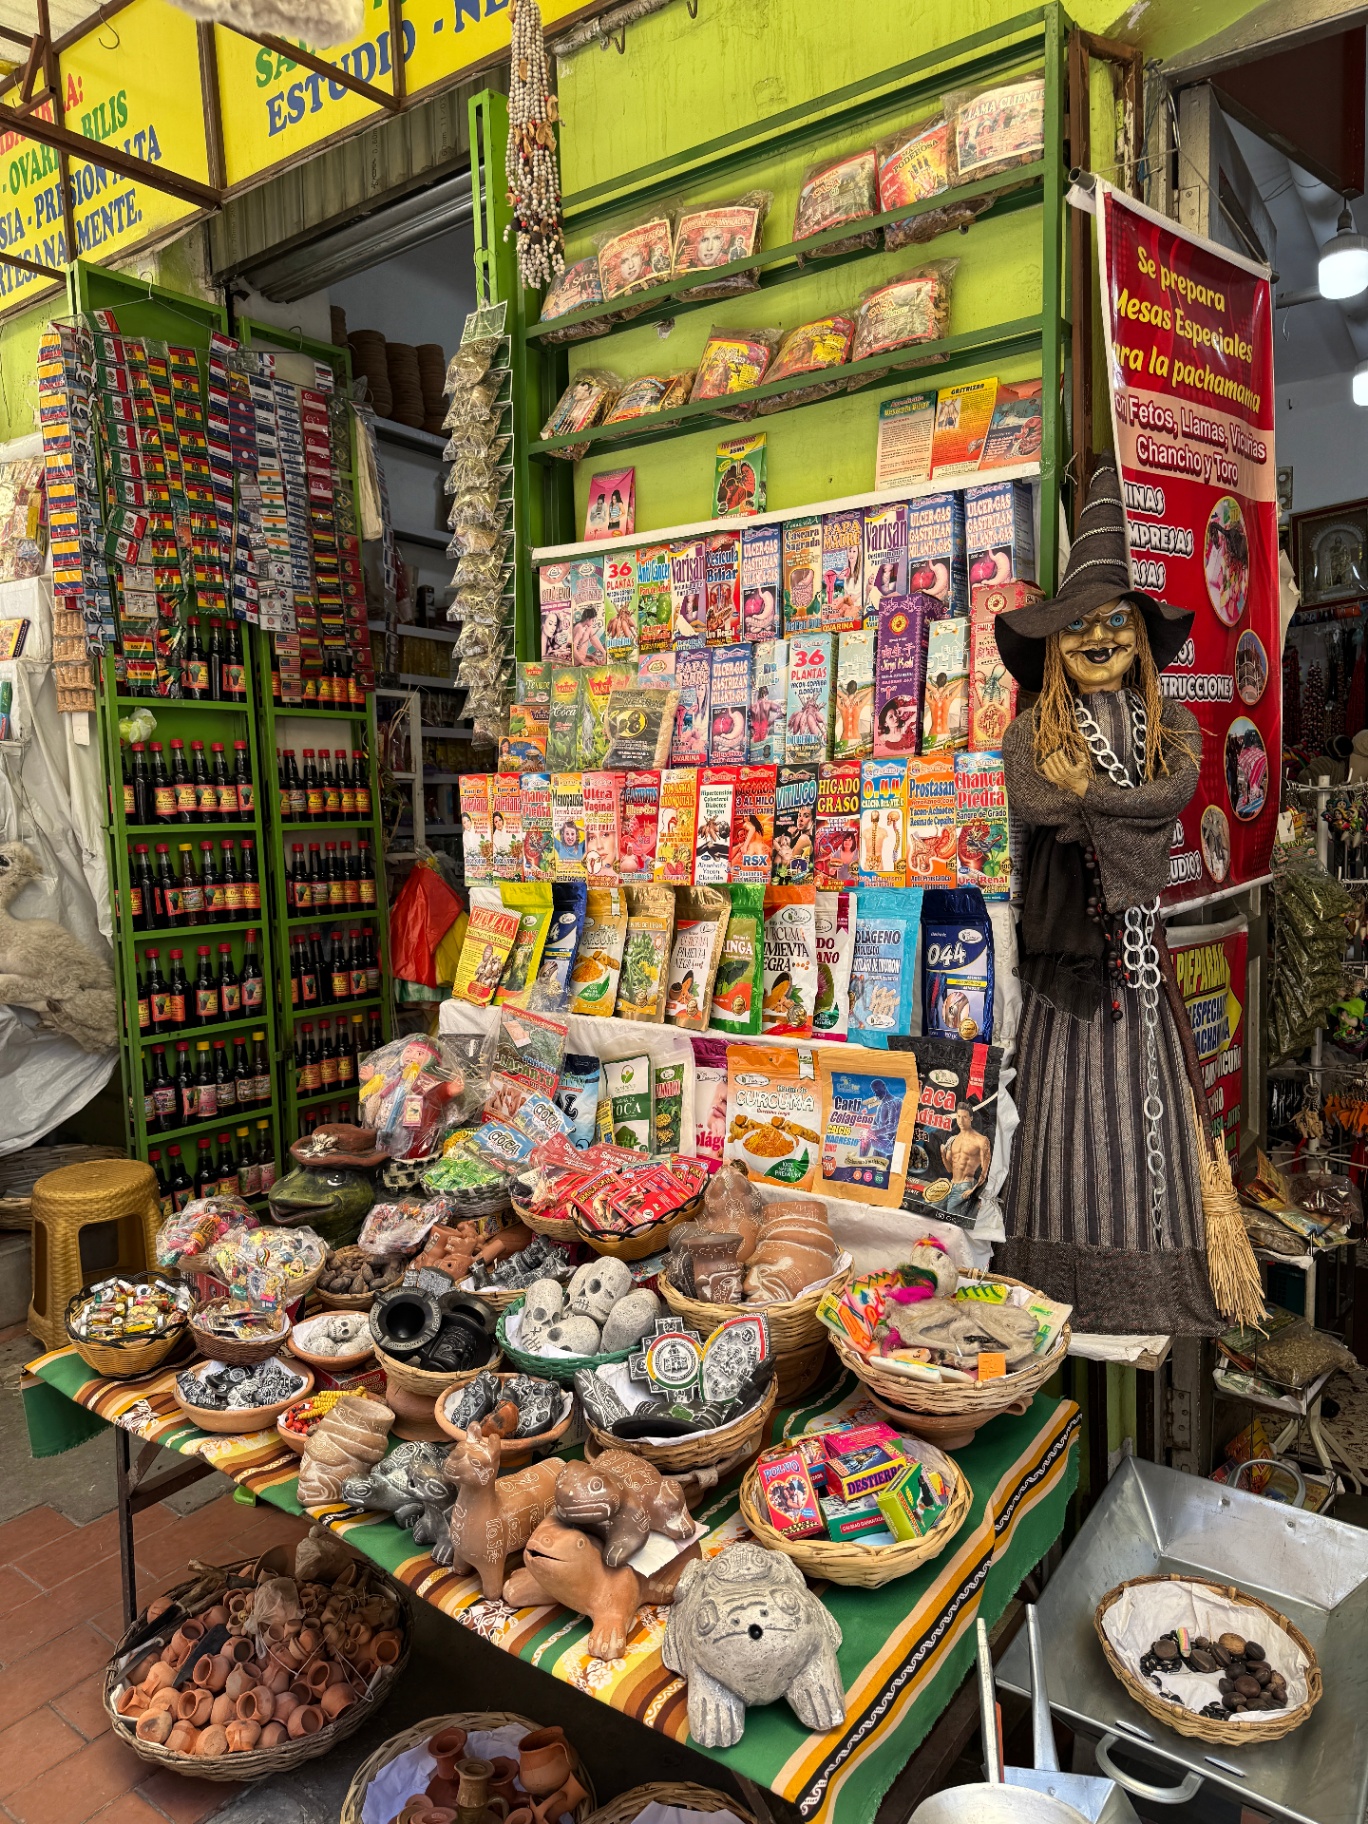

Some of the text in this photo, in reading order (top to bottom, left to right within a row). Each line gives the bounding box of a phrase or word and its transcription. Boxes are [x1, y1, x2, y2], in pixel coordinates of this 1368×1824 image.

[892, 139, 938, 173] PODEROSA
[1138, 246, 1225, 313] Se prepara
[1175, 308, 1253, 363] Especiales
[1149, 346, 1167, 377] la
[1173, 360, 1261, 414] pachamama
[1130, 394, 1178, 434] Fetos,
[1181, 407, 1228, 446] Llamas,
[1137, 435, 1238, 487] Chancho y Toro
[966, 494, 1011, 517] ULCER-GAS
[910, 507, 951, 527] ULCER-GAS
[966, 509, 1013, 533] GASTRIZAN
[824, 520, 862, 536] PAPA
[865, 518, 908, 552] Varisan
[909, 522, 952, 542] GASTRIZAN
[1127, 522, 1193, 557] MPRESAS
[608, 562, 632, 578] 36
[670, 554, 706, 586] Varisan
[707, 568, 739, 582] Biliar
[1132, 562, 1166, 589] ASAS
[606, 578, 635, 590] PLANTAS
[822, 622, 853, 632] OVARINA
[676, 660, 710, 673] PAPA
[794, 648, 826, 668] 36
[791, 667, 827, 681] PLANTAS
[1159, 675, 1234, 702] TRUCCIONES
[672, 754, 700, 763] OVARINA
[818, 777, 860, 795] HIGADO
[862, 778, 901, 799] 0.44
[908, 778, 955, 799] Prostasan
[954, 771, 1005, 790] Chanca
[583, 788, 613, 800] Ultra
[736, 795, 775, 806] 3 AL HILO
[776, 780, 817, 810] VITILIGO
[957, 789, 1005, 809] Piedra
[522, 805, 552, 819] Piedra
[584, 801, 615, 813] Vaginal
[817, 796, 860, 813] GRASO
[956, 811, 977, 821] Sangre
[987, 809, 1007, 818] Grado
[743, 855, 768, 867] RSX
[957, 875, 1008, 885] Uro Renal
[764, 926, 806, 942] URCUMA
[723, 940, 754, 955] INGA
[764, 942, 810, 958] MIENTA
[927, 941, 967, 967] 044
[736, 1089, 815, 1113] CURCUMA
[834, 1096, 862, 1112] Carti
[919, 1085, 957, 1111] aca
[533, 1103, 563, 1133] COCA
[487, 1129, 522, 1155] COCA
[825, 1135, 859, 1147] MAGNESIO
[764, 1460, 800, 1482] POLVO
